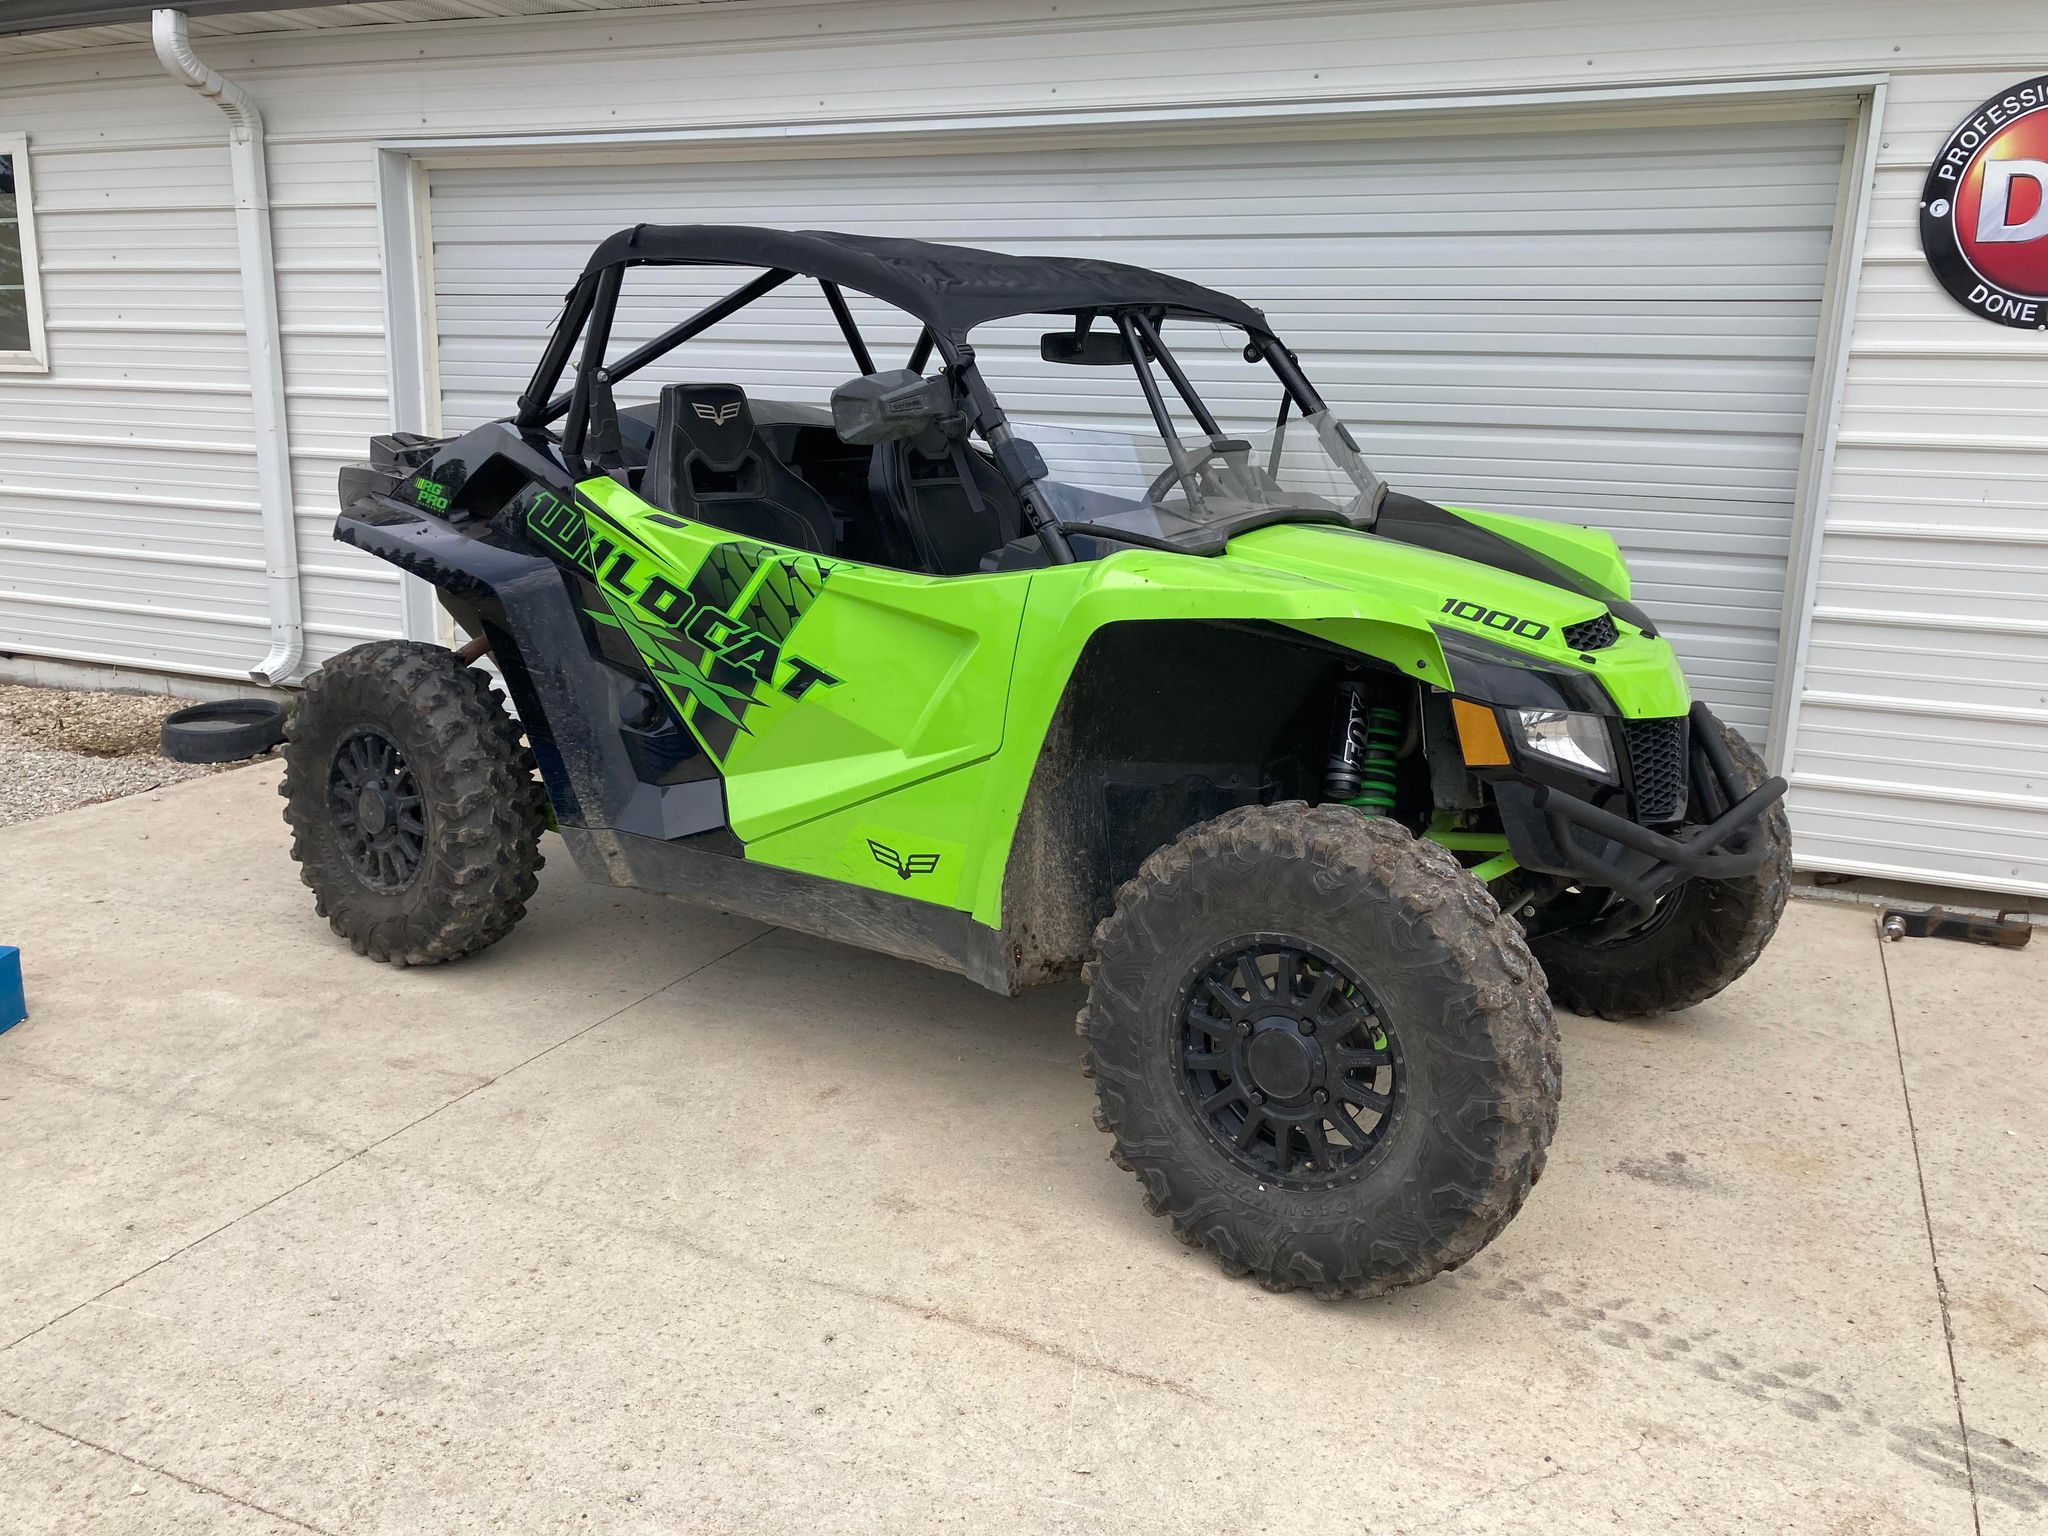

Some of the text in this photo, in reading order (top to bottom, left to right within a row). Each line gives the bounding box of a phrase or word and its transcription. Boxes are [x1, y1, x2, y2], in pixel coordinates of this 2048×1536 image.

[1939, 85, 2048, 181] PROFESSI
[1967, 284, 2039, 322] DONE
[417, 490, 448, 509] PRO
[527, 491, 846, 703] WILDCAT
[1440, 598, 1549, 640] 1000
[1344, 690, 1369, 772] FOX
